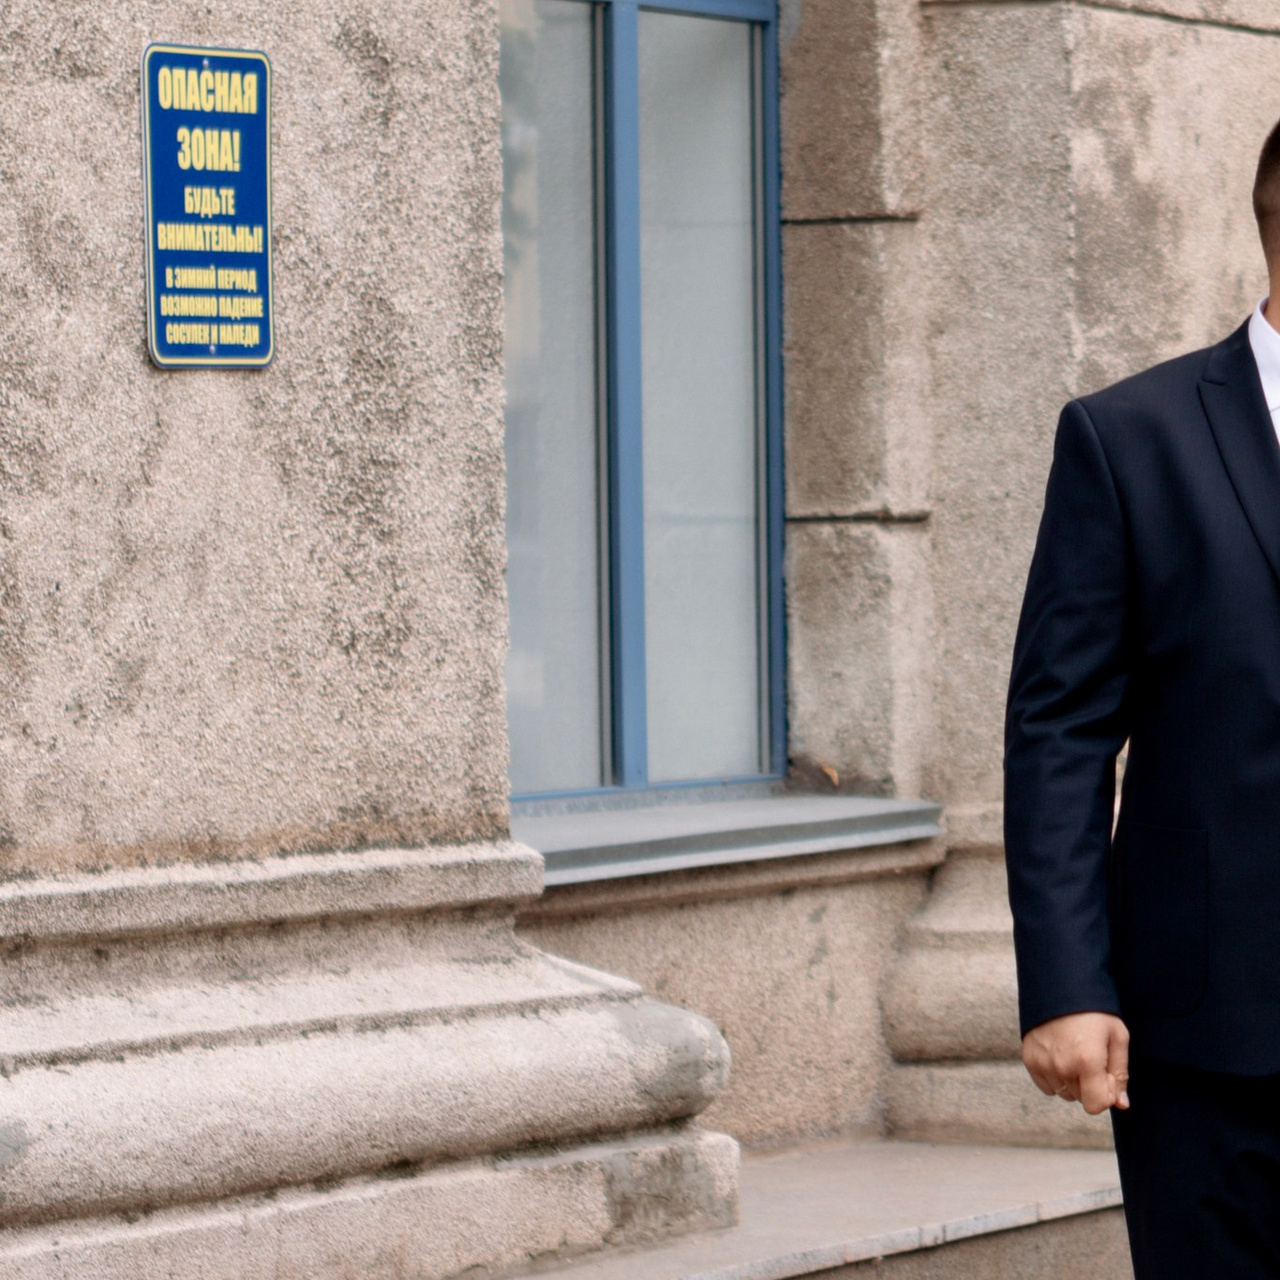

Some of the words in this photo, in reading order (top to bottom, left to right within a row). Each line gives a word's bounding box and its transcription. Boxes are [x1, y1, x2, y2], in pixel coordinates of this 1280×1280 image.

[158, 66, 257, 114] ОПАСНАЯ
[177, 126, 240, 172] ЗОНА!
[184, 186, 235, 218] БУДЬТЕ
[157, 223, 263, 253] ВНИМАТЕЛЬНЫ!
[166, 267, 173, 288] В
[175, 265, 216, 288] ЗИМНИЙ
[217, 268, 256, 292] ПЕРИОД
[160, 295, 217, 316] ВОЗМОЖНО
[219, 296, 263, 320] ПАДЕНИЕ
[166, 323, 210, 344] СОСУЛЕК
[211, 324, 218, 344] И
[219, 324, 259, 347] НАЛЕДИ
